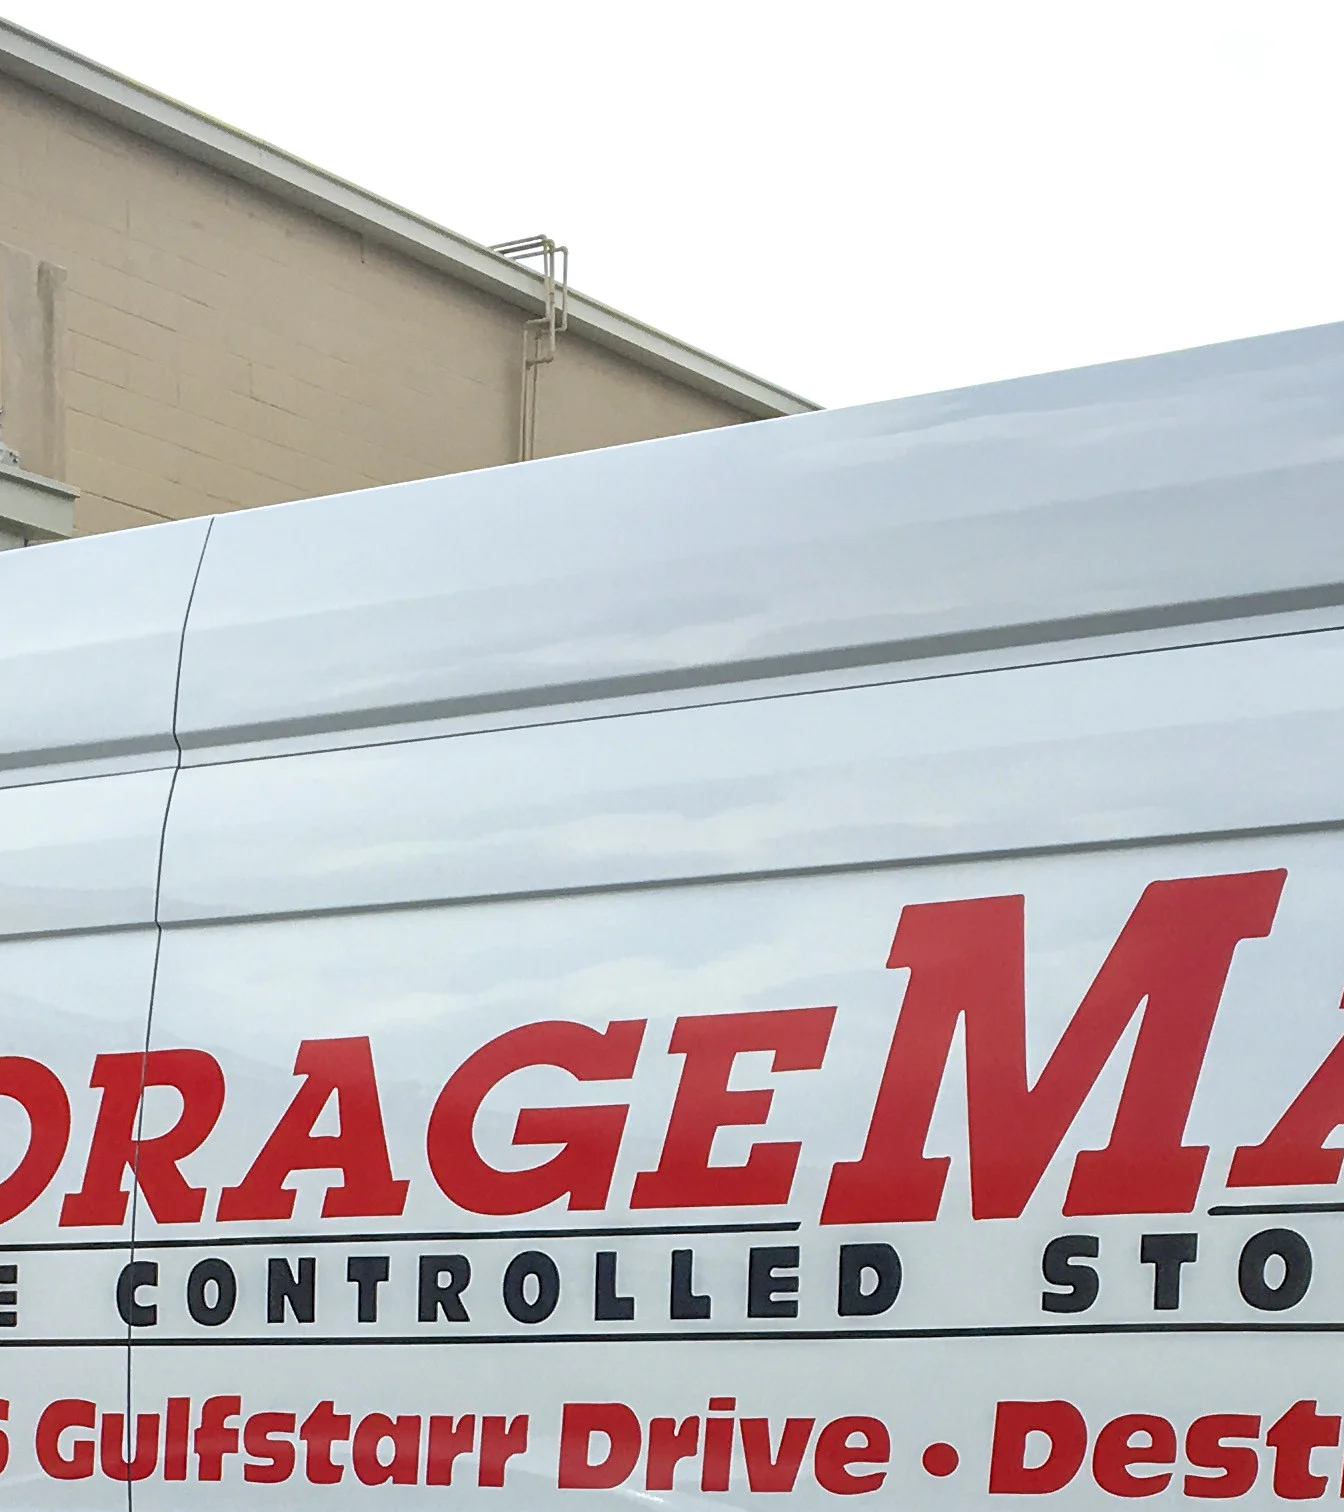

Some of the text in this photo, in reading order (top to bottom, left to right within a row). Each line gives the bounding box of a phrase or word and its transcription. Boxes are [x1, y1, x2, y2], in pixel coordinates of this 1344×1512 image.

[115, 1242, 904, 1328] CONTROLLED
[35, 1395, 529, 1488] Gulfstarr
[558, 1397, 890, 1495] Drive
